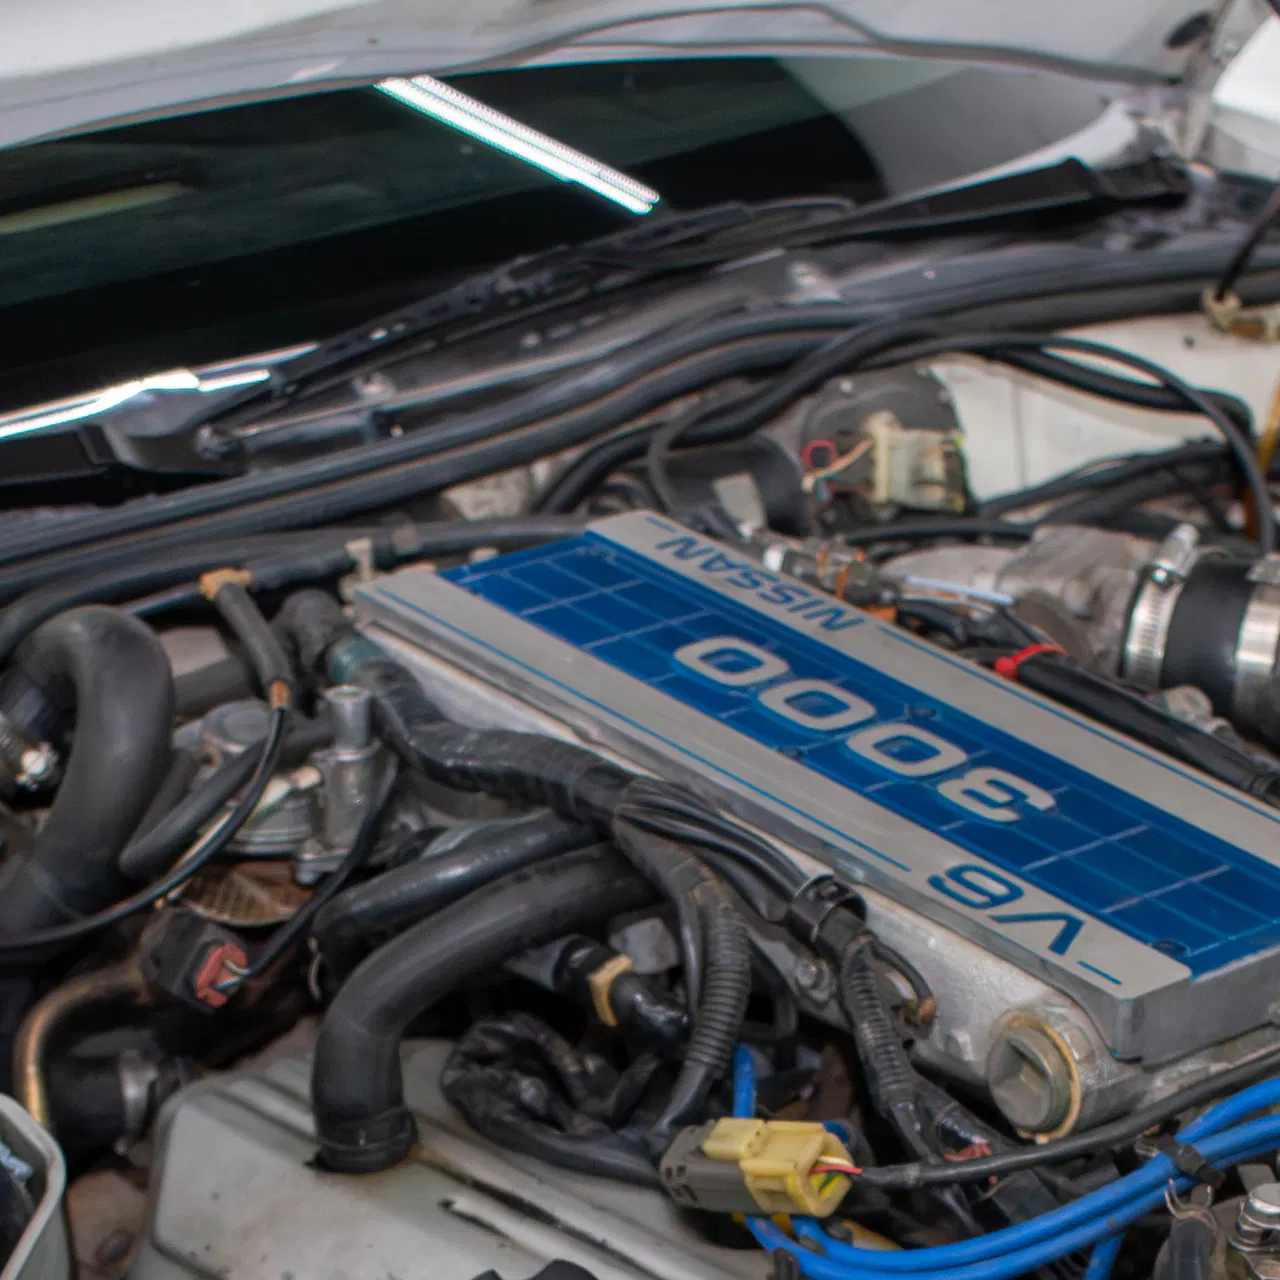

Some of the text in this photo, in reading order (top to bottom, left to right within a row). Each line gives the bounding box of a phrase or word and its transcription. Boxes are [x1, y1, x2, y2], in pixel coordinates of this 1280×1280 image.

[655, 536, 862, 632] NISSAN
[673, 636, 1056, 823] 3000
[927, 862, 1086, 958] V6
